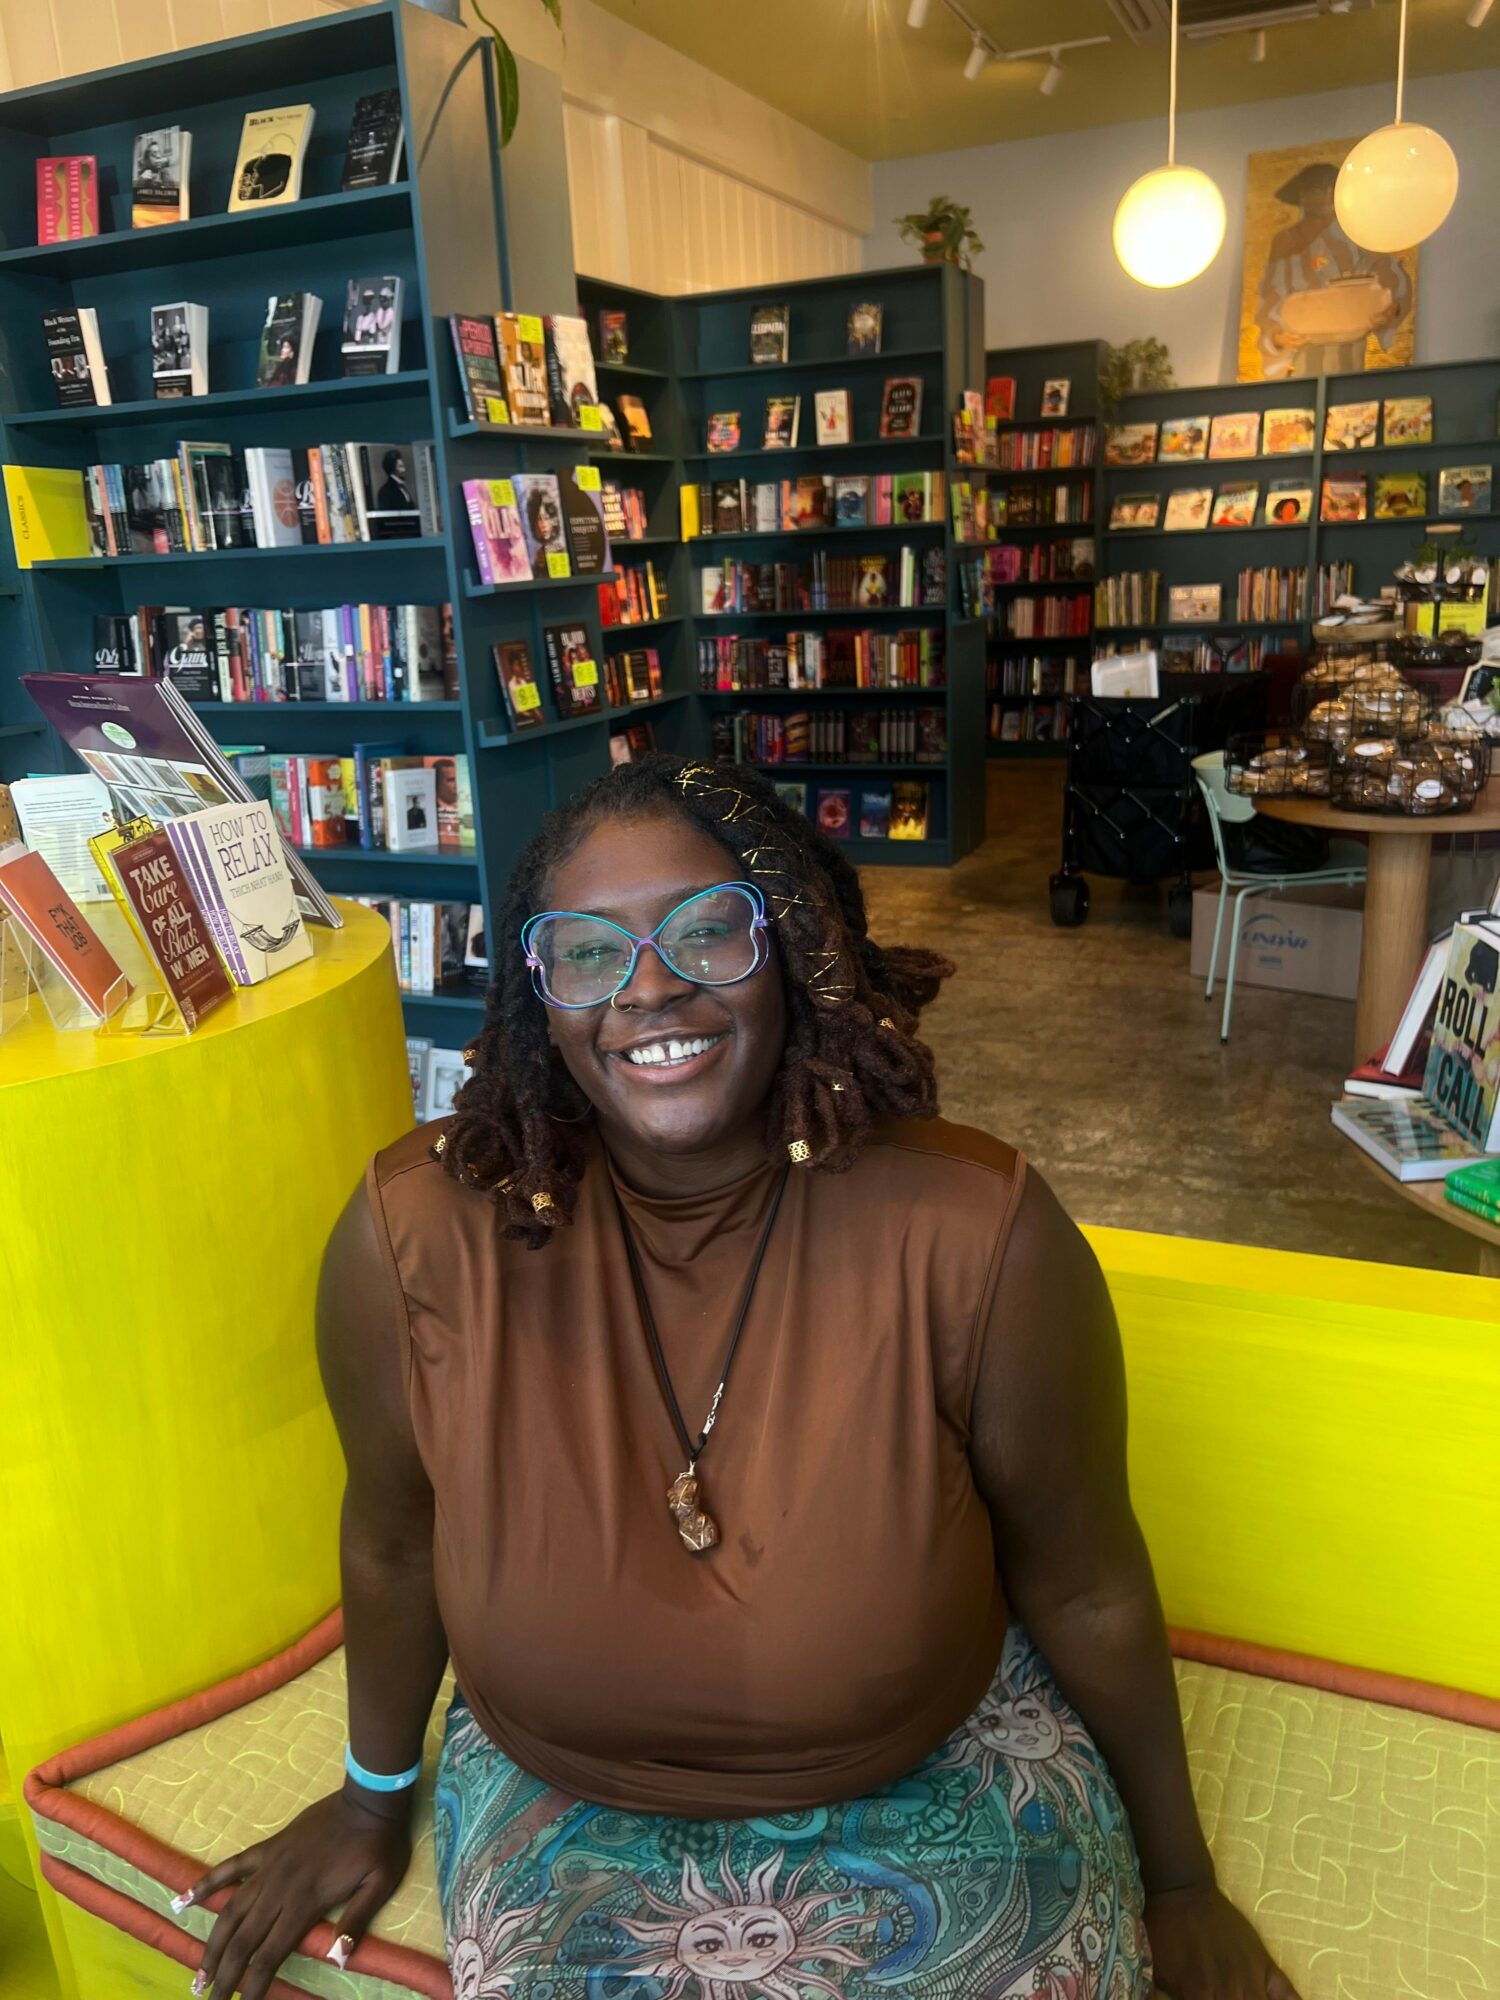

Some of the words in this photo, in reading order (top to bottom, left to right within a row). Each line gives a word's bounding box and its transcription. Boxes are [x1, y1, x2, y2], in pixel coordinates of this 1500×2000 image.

[17, 495, 30, 541] CLASSICS
[467, 498, 482, 526] LILAC
[209, 816, 244, 846] HOW
[246, 810, 268, 833] TO
[129, 854, 175, 890] TAKE
[217, 833, 278, 881] RELAX
[140, 879, 181, 914] Care
[229, 883, 252, 899] THICH
[56, 916, 80, 938] THAT
[152, 915, 168, 937] OF
[167, 902, 193, 930] ALL
[209, 909, 220, 925] HOW
[219, 908, 231, 924] HOW
[230, 933, 241, 955] RELAX
[71, 931, 88, 951] JOB
[160, 920, 200, 963] Black
[1440, 977, 1488, 1061] ROLL
[1436, 1053, 1485, 1139] CALL
